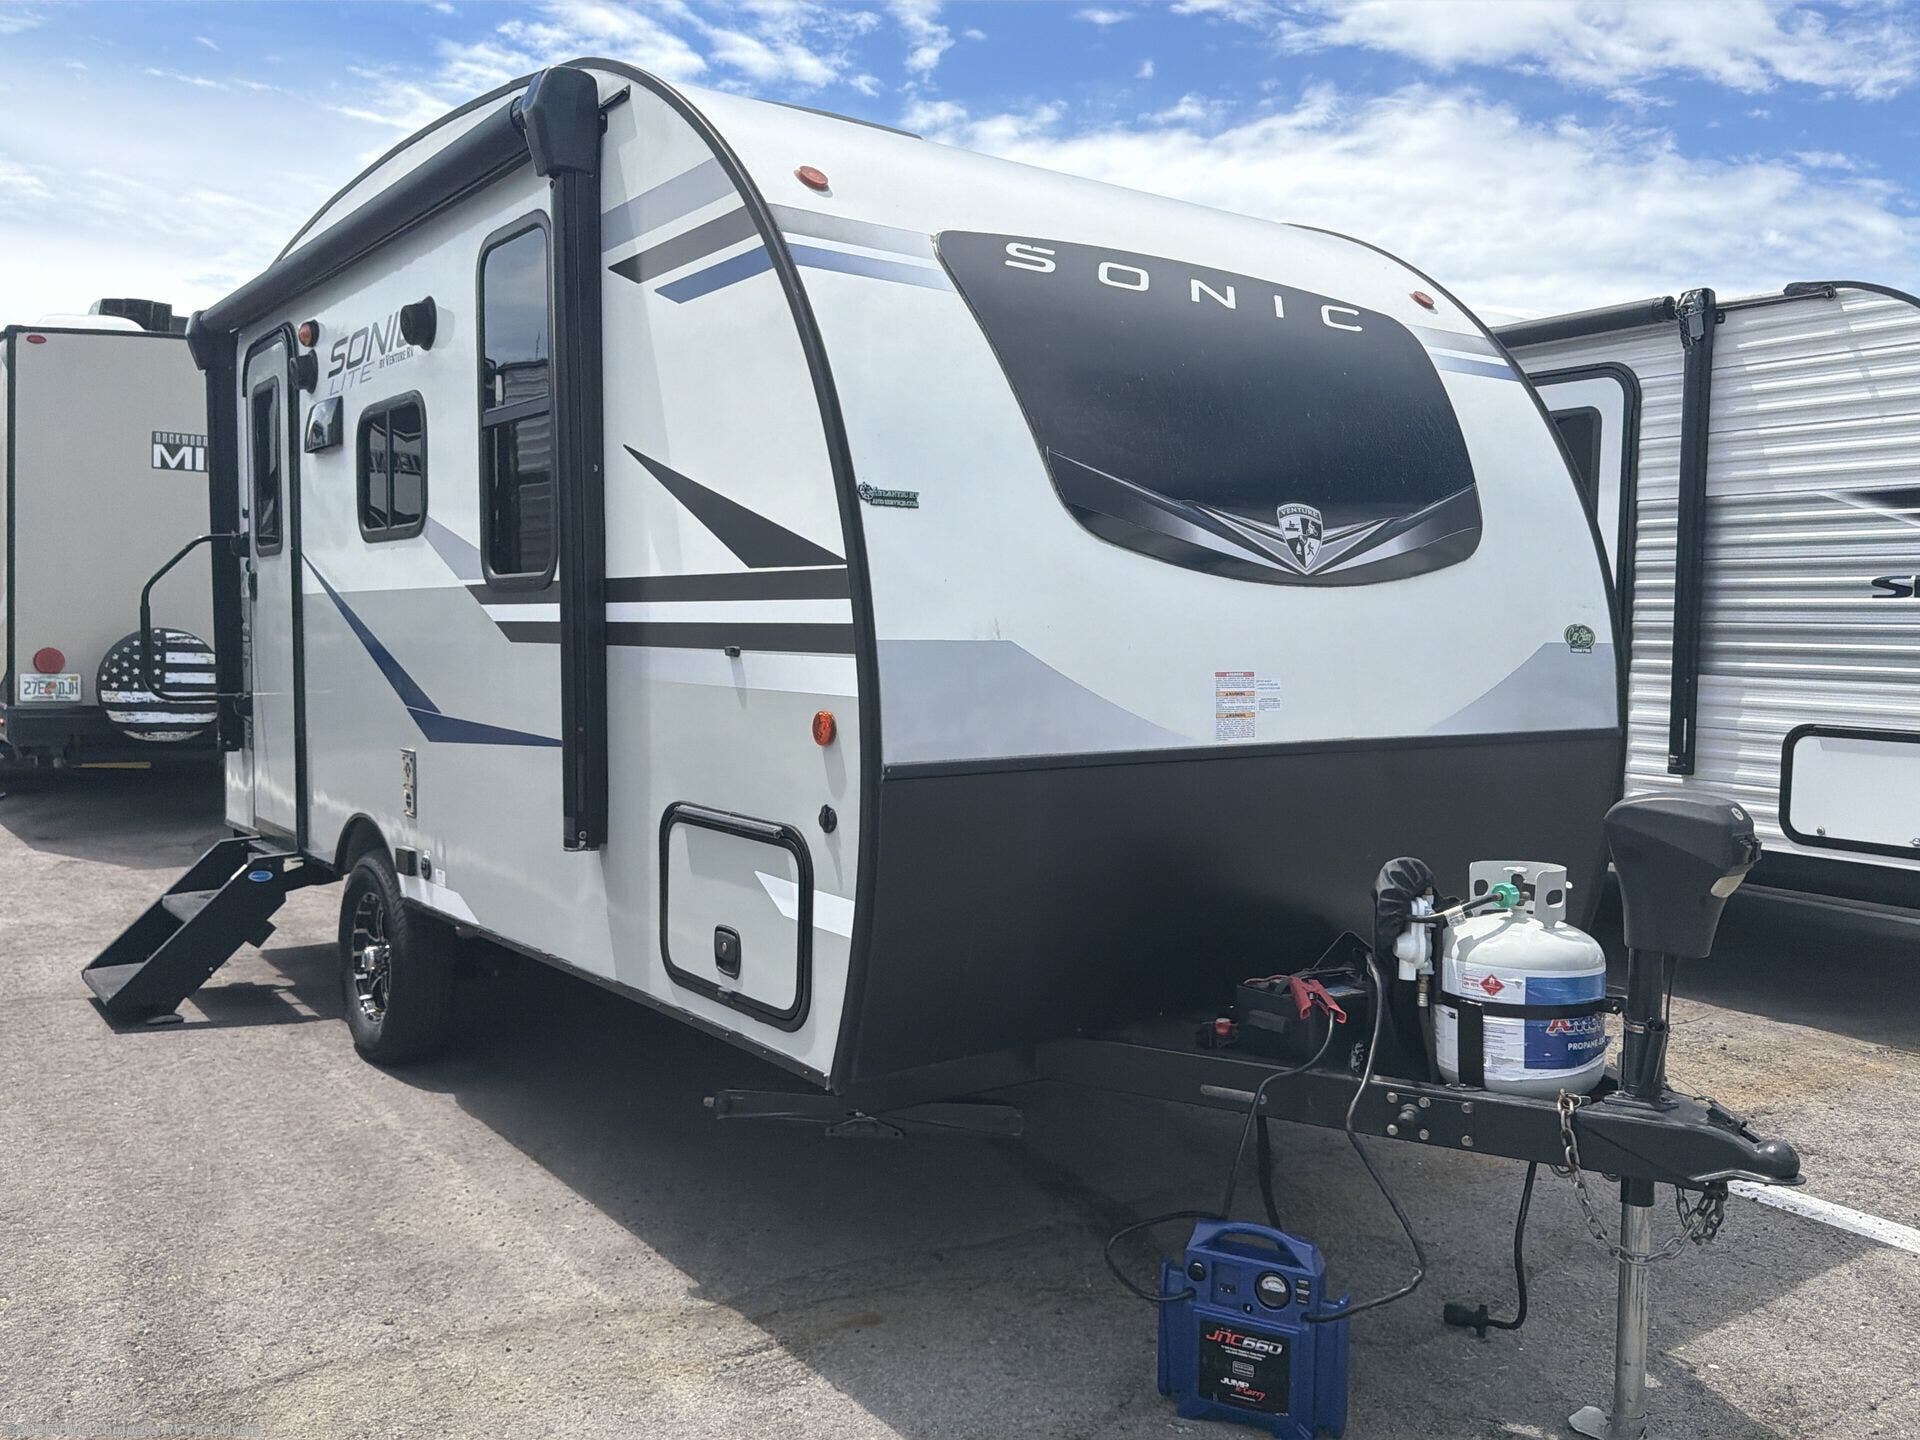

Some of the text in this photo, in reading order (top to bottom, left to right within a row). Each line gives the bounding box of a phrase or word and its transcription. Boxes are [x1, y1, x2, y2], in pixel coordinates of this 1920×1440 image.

[1005, 242, 1363, 332] SONIC
[329, 361, 375, 396] LITE
[153, 444, 205, 470] MI
[1280, 507, 1319, 518] VENTURE
[1567, 1039, 1598, 1051] PROPANE
[1220, 1377, 1249, 1388] JUMP
